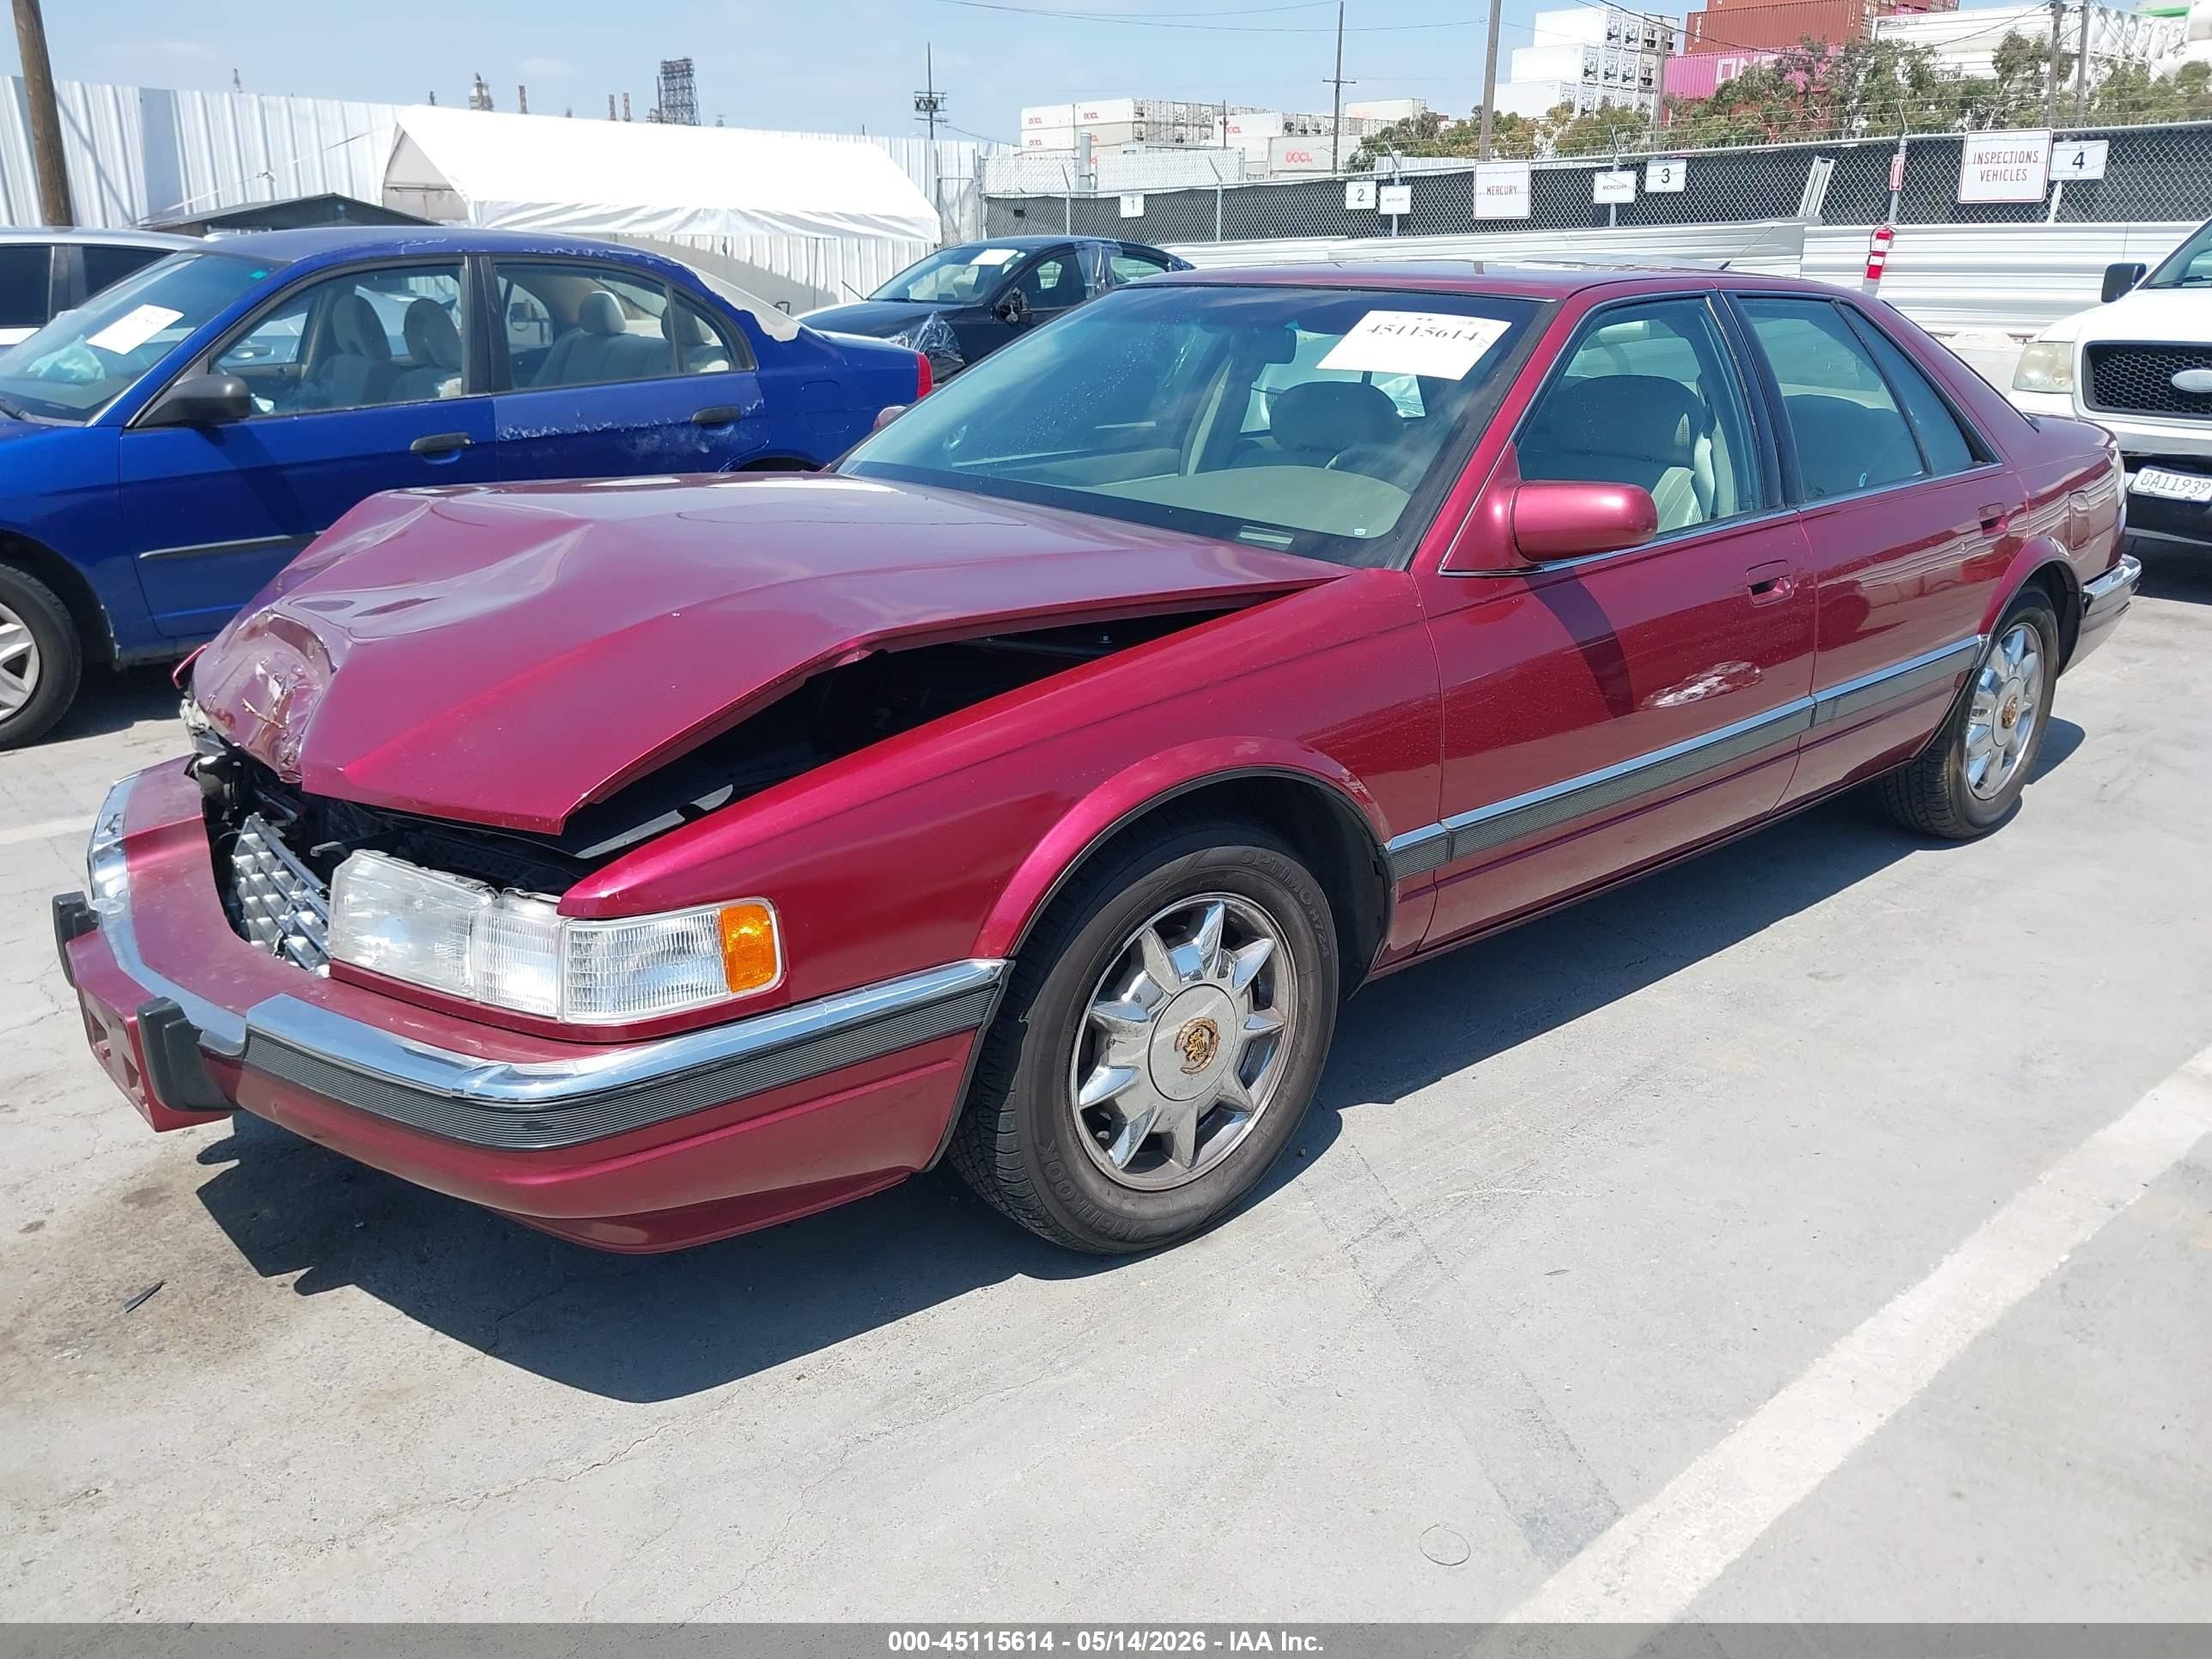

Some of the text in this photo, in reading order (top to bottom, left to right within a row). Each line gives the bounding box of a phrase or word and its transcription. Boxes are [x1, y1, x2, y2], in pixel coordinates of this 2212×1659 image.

[1083, 112, 1099, 120] OOCL
[1285, 149, 1313, 163] OOCL
[1972, 150, 2039, 165] INSPECTIONS
[2072, 151, 2085, 170] 4
[1661, 167, 1671, 184] 3
[1980, 168, 2027, 182] VEHICLES
[1357, 188, 1365, 202] 2
[1486, 185, 1518, 196] MERCURY
